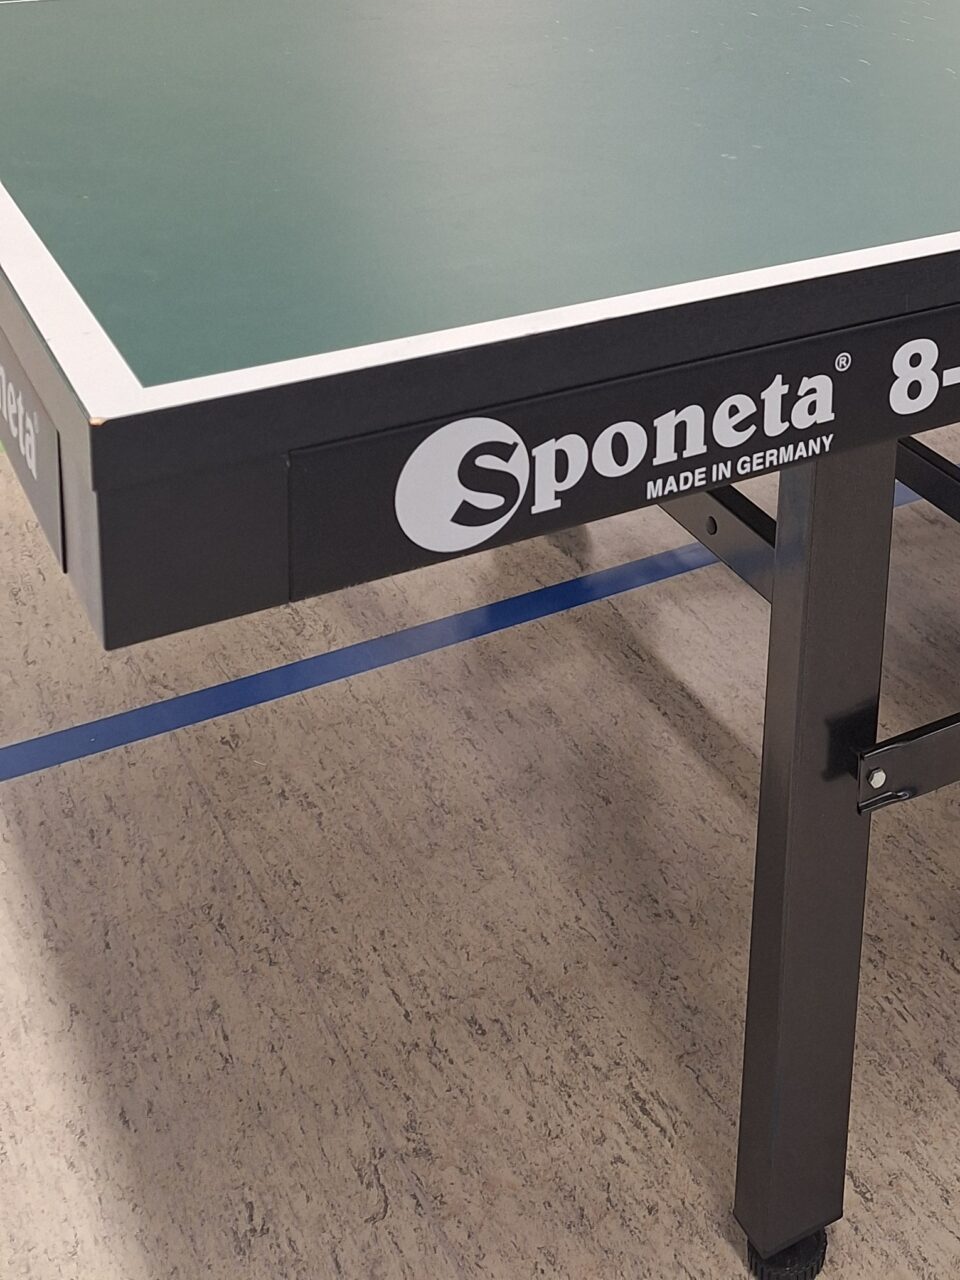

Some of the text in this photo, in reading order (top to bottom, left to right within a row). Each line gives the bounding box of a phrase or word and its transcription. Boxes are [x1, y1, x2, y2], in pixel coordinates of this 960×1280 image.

[646, 433, 834, 501] MADE IN GERMANY
